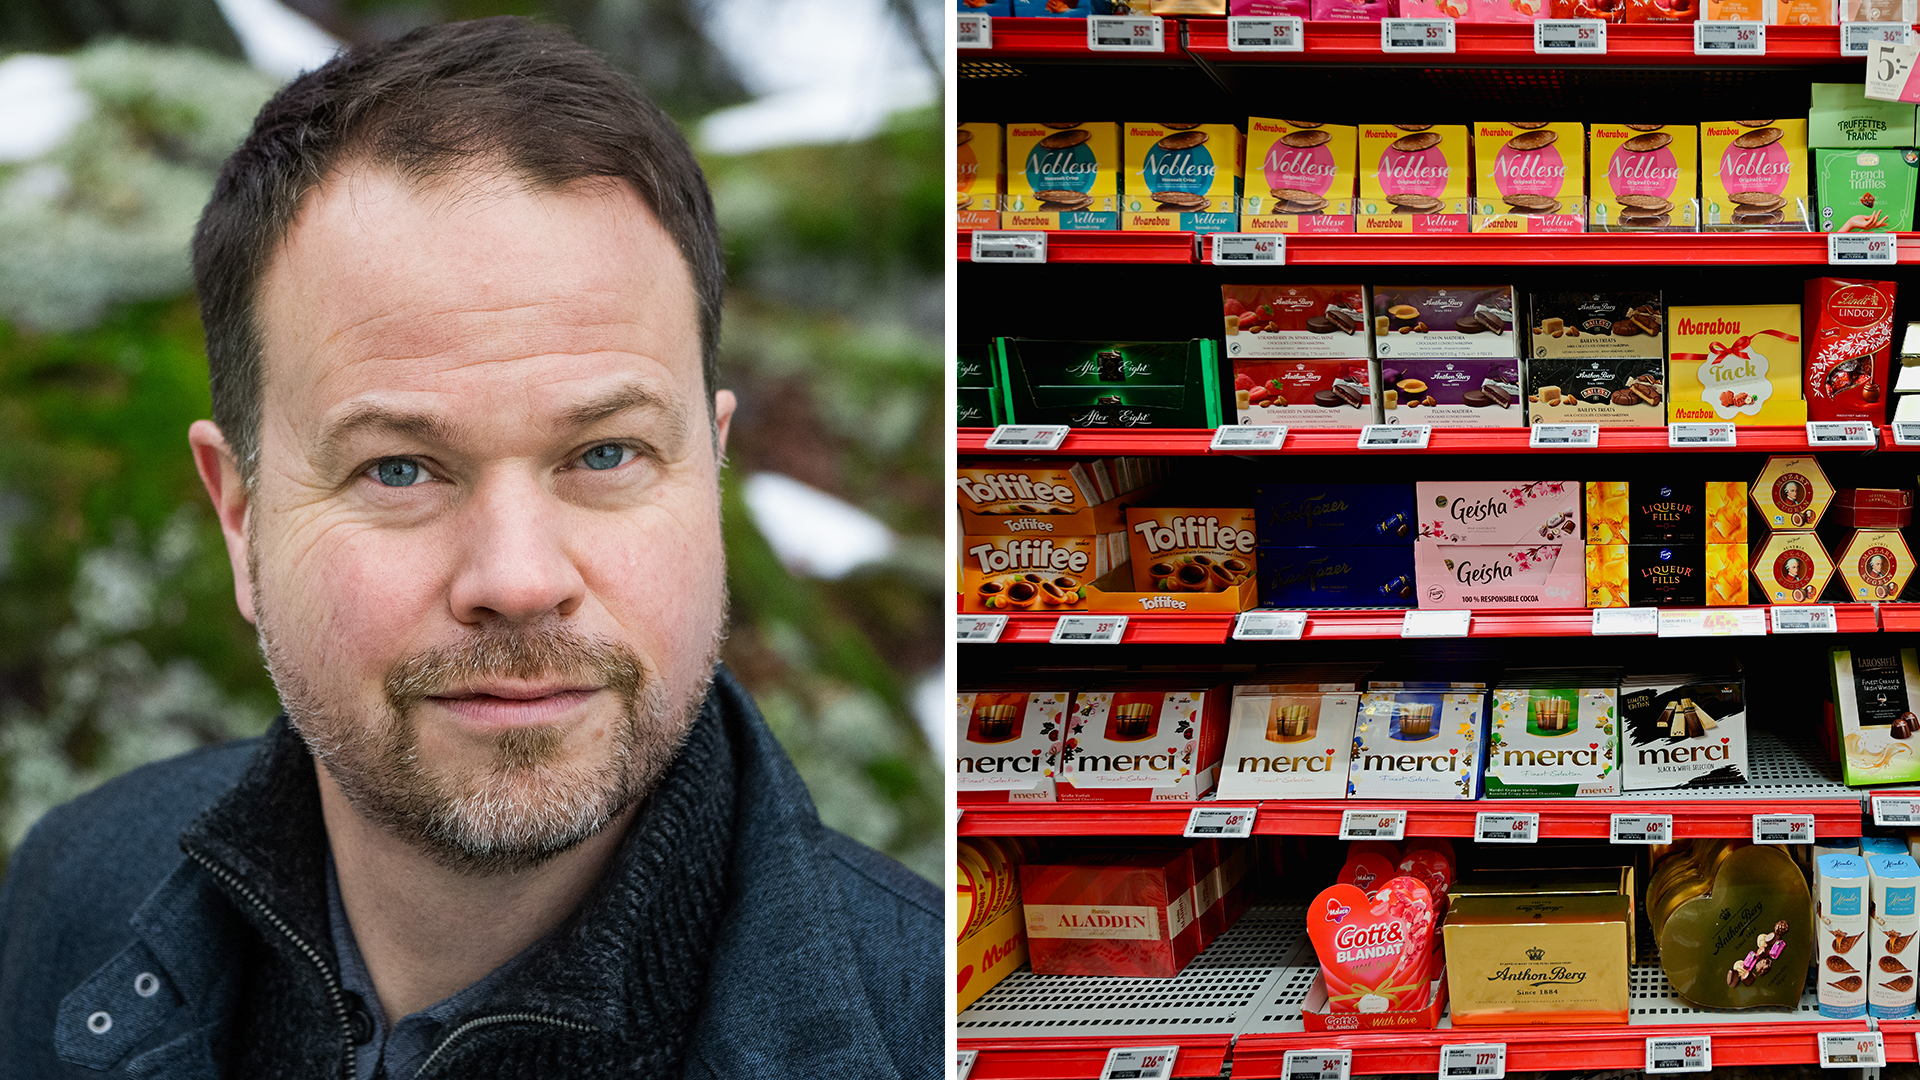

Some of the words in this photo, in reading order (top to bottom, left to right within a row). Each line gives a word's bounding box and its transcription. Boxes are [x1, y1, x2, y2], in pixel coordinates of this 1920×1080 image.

[1254, 122, 1287, 134] Marabou
[1706, 127, 1739, 136] Marabou
[1837, 119, 1887, 131] TRUFFETTES
[1012, 128, 1046, 137] Marabou
[1130, 127, 1164, 137] Marabou
[1364, 129, 1398, 139] Marabou
[1480, 127, 1513, 137] Marabou
[1596, 128, 1629, 139] Marabou
[1846, 129, 1878, 141] FRANCE
[1018, 152, 1101, 175] Noblesse
[1136, 153, 1219, 177] Noblesse
[1256, 150, 1340, 177] Noblesse
[1371, 155, 1453, 178] Noblesse
[1487, 154, 1568, 178] Noblesse
[1601, 156, 1682, 179] Noblesse
[1713, 152, 1794, 176] Noblesse
[1850, 169, 1884, 179] French
[1849, 178, 1886, 189] Truffles
[1012, 216, 1049, 226] Marabou
[1133, 216, 1170, 226] Marabou
[1251, 218, 1288, 228] Marabou
[1366, 217, 1403, 228] Marabou
[1481, 217, 1518, 229] Marabou
[1298, 297, 1314, 307] Berg
[1423, 298, 1448, 306] Anthon
[1448, 298, 1463, 308] Berg
[1838, 292, 1871, 306] Lindt
[1577, 303, 1601, 311] Anthon
[1601, 303, 1616, 312] Berg
[1839, 309, 1875, 318] LINDOR
[1677, 317, 1741, 336] Marabou
[1066, 361, 1102, 375] After
[1118, 361, 1151, 375] Eight
[1709, 362, 1757, 383] Tack
[1281, 372, 1306, 380] Anthon
[1306, 372, 1322, 382] Berg
[1430, 372, 1456, 380] Anthon
[1456, 372, 1471, 382] Berg
[1576, 371, 1600, 379] Anthon
[1600, 371, 1616, 381] Berg
[1072, 409, 1108, 425] After
[1119, 409, 1152, 425] Eight
[1675, 408, 1714, 419] Marabou
[1775, 473, 1810, 488] MOZART
[957, 473, 1075, 504] Toffifee
[1450, 497, 1507, 524] Geisha
[1642, 502, 1693, 515] LIQUEUR
[1776, 499, 1810, 514] KUGELN
[1652, 513, 1681, 521] FILLS
[1004, 518, 1054, 532] Toffifee
[1134, 516, 1256, 555] Toffifee
[969, 539, 1089, 574] Toffifee
[1777, 550, 1810, 564] MOZART
[1862, 547, 1894, 561] MOZART
[1457, 561, 1513, 586] Geisha
[1641, 565, 1693, 578] LIQUEUR
[1652, 576, 1680, 584] FILLS
[1777, 576, 1810, 590] KUGELN
[1861, 573, 1893, 586] KUGELN
[1138, 595, 1187, 610] Toffifee
[1480, 595, 1519, 603] RESPONSIBLE
[1519, 595, 1539, 603] COCOA
[1858, 656, 1898, 667] LAROSHELL
[1627, 695, 1649, 704] LIMITED
[1628, 701, 1650, 710] EDITION
[1504, 742, 1598, 766] merci
[1638, 737, 1730, 765] merci
[1078, 747, 1175, 772] merci
[1237, 748, 1335, 773] merci
[1363, 748, 1457, 772] merci
[1549, 769, 1583, 777] Selection
[1692, 763, 1715, 771] SELECTION
[988, 776, 1023, 784] Selection
[1126, 774, 1160, 782] Selection
[1013, 791, 1048, 799] merci
[1155, 792, 1190, 800] merci
[1581, 785, 1614, 794] merci
[992, 877, 1005, 912] Marabou
[1833, 892, 1859, 907] Hamlet
[1887, 892, 1913, 907] Hamlet
[973, 891, 986, 927] Marabou
[1057, 914, 1146, 928] ALADDIN
[1335, 920, 1404, 950] Gott&
[1713, 921, 1745, 955] Anthon
[1741, 902, 1763, 924] Berg
[1336, 942, 1403, 963] BLANDAT
[1352, 963, 1372, 975] With
[1375, 960, 1393, 971] love
[1487, 967, 1548, 981] Anthon
[1548, 966, 1587, 985] Berg
[1325, 1016, 1359, 1026] Gott&
[1372, 1017, 1396, 1027] With
[1397, 1016, 1417, 1025] love
